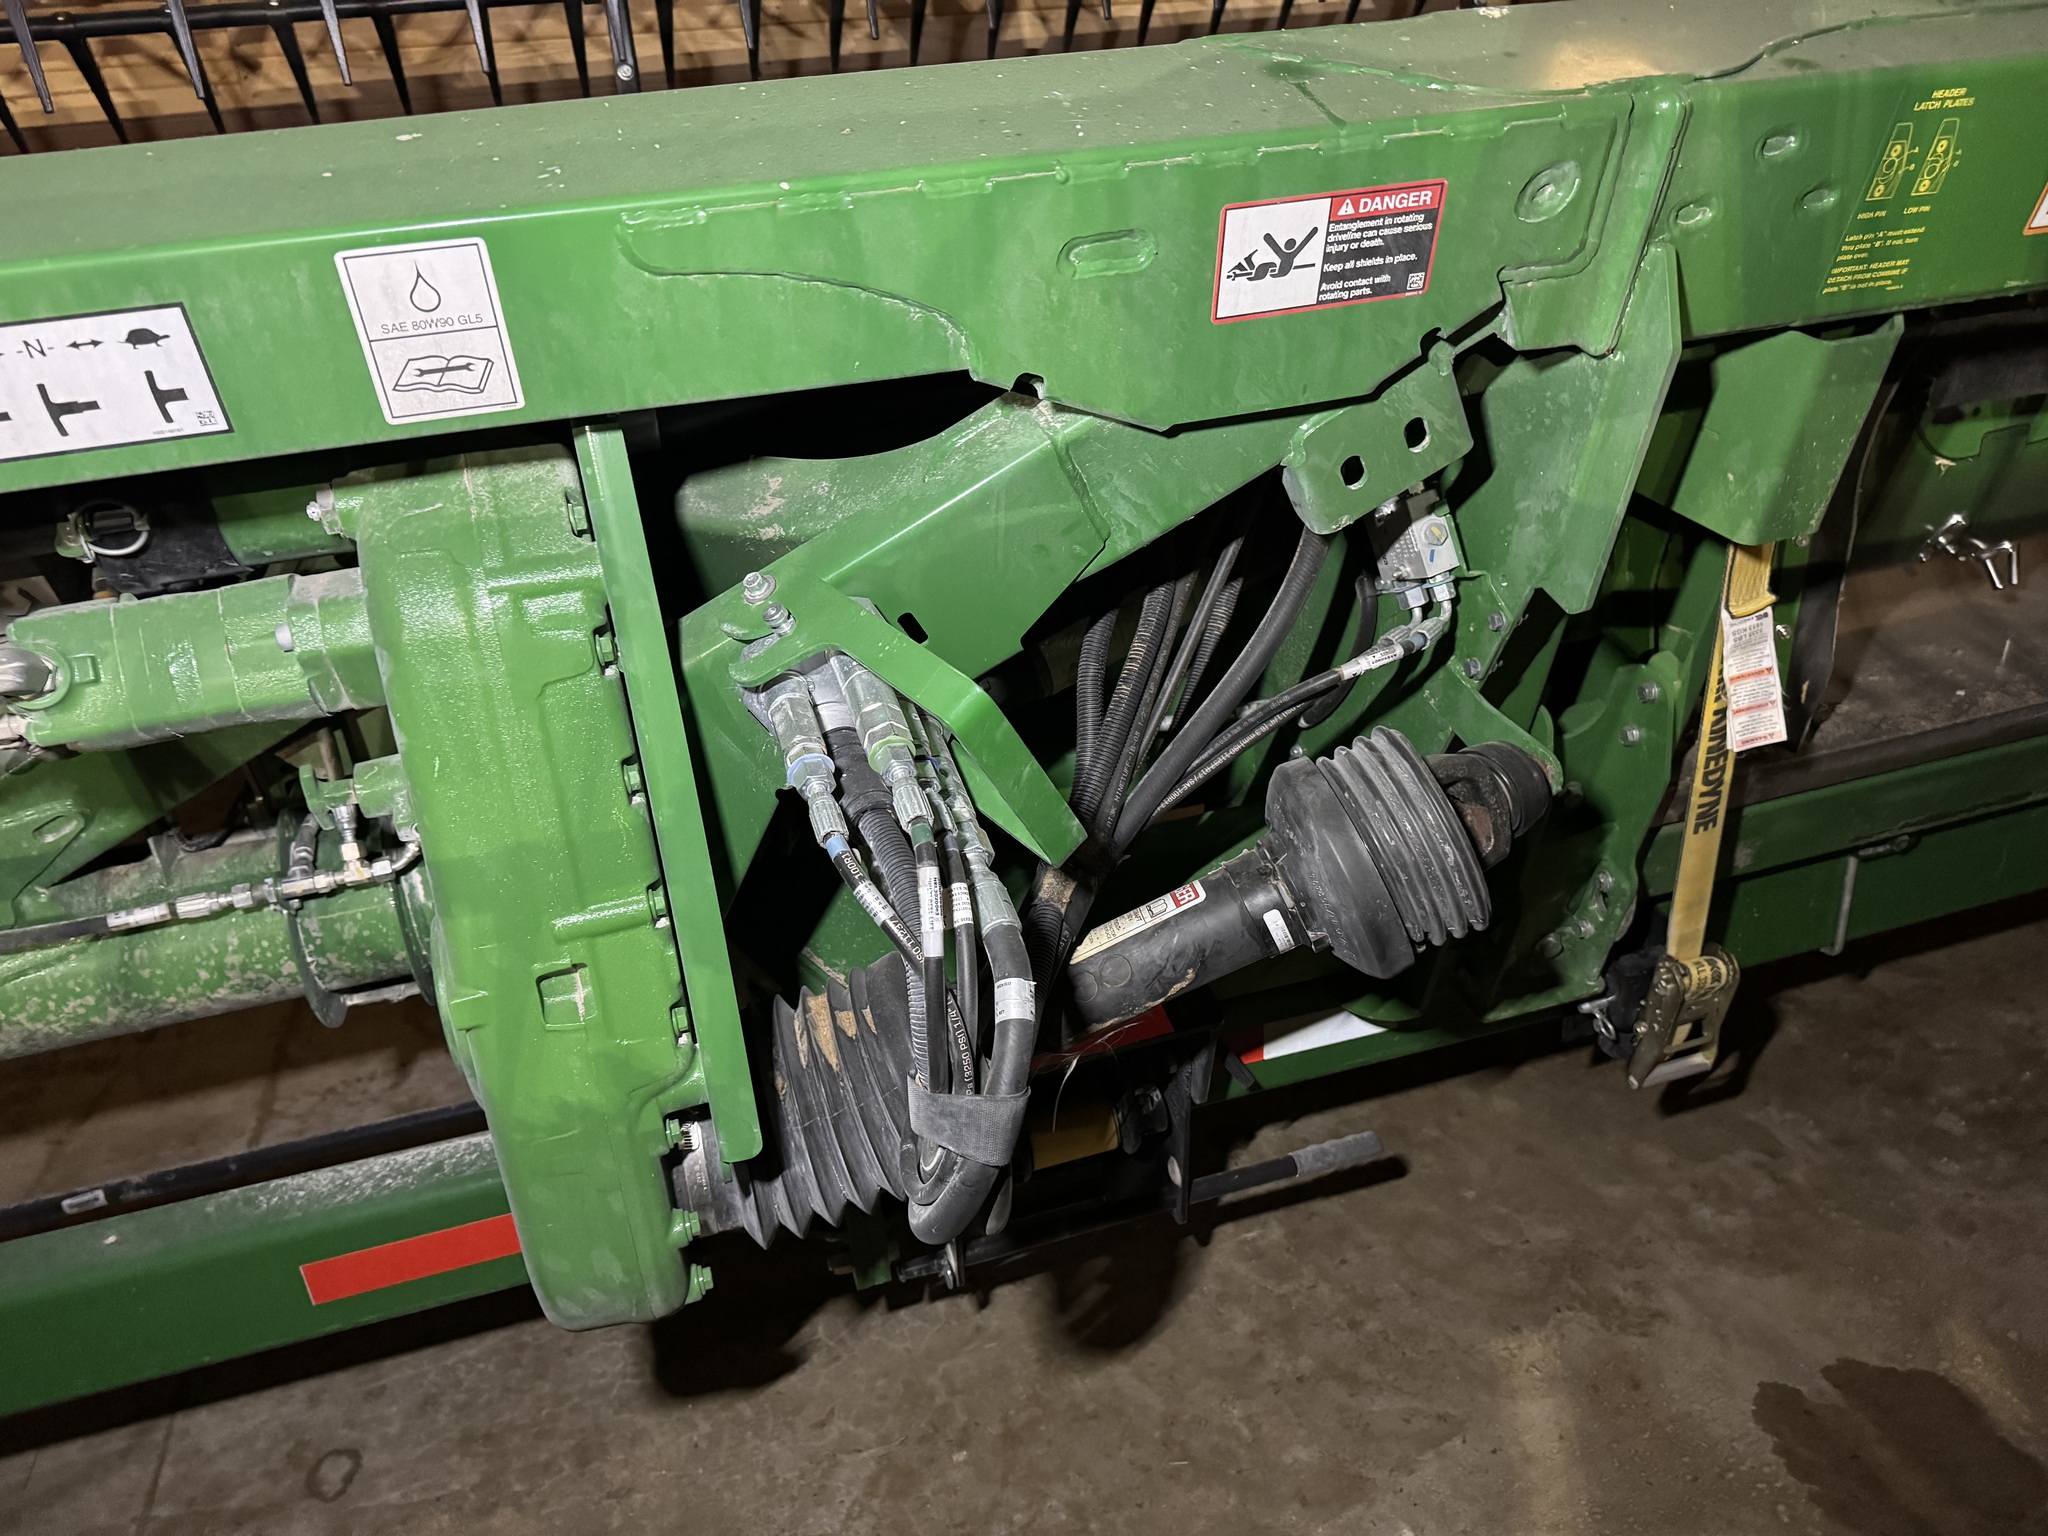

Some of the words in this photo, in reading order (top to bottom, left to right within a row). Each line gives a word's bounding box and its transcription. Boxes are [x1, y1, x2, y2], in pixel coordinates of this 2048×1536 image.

[1932, 88, 1967, 98] HEADER
[1914, 101, 1941, 111] LATCH
[1943, 98, 1975, 108] PLATES
[1358, 190, 1432, 213] DANGER
[1329, 218, 1384, 232] Entanglement
[1384, 216, 1392, 224] in
[1394, 213, 1425, 224] rotating
[1857, 211, 1874, 220] HIGH
[1327, 231, 1361, 242] driveline
[1363, 230, 1377, 238] can
[1379, 227, 1402, 235] cause
[1403, 222, 1433, 232] serious
[1326, 243, 1349, 254] injury
[1360, 238, 1384, 248] death.
[1323, 263, 1344, 272] Keep
[1344, 260, 1355, 269] all
[1356, 256, 1384, 268] shields
[1385, 255, 1393, 263] in
[1394, 253, 1418, 264] place.
[1836, 254, 1853, 262] plate
[1869, 260, 1896, 269] HEADER
[1320, 280, 1343, 291] Avoid
[1344, 277, 1373, 288] contact
[1374, 274, 1391, 283] with
[1827, 275, 1853, 284] DETACH
[1872, 269, 1900, 278] COMBINE
[1319, 290, 1349, 301] rotating
[1350, 287, 1372, 298] parts.
[381, 322, 409, 334] SAE
[412, 317, 454, 330] 80W90
[457, 313, 483, 325] GL5
[1693, 708, 1727, 834] KINEDYNE
[841, 852, 864, 880] 100R1
[891, 918, 915, 947] 11237
[956, 1029, 968, 1050] PSI)
[962, 1051, 972, 1082] (3250
